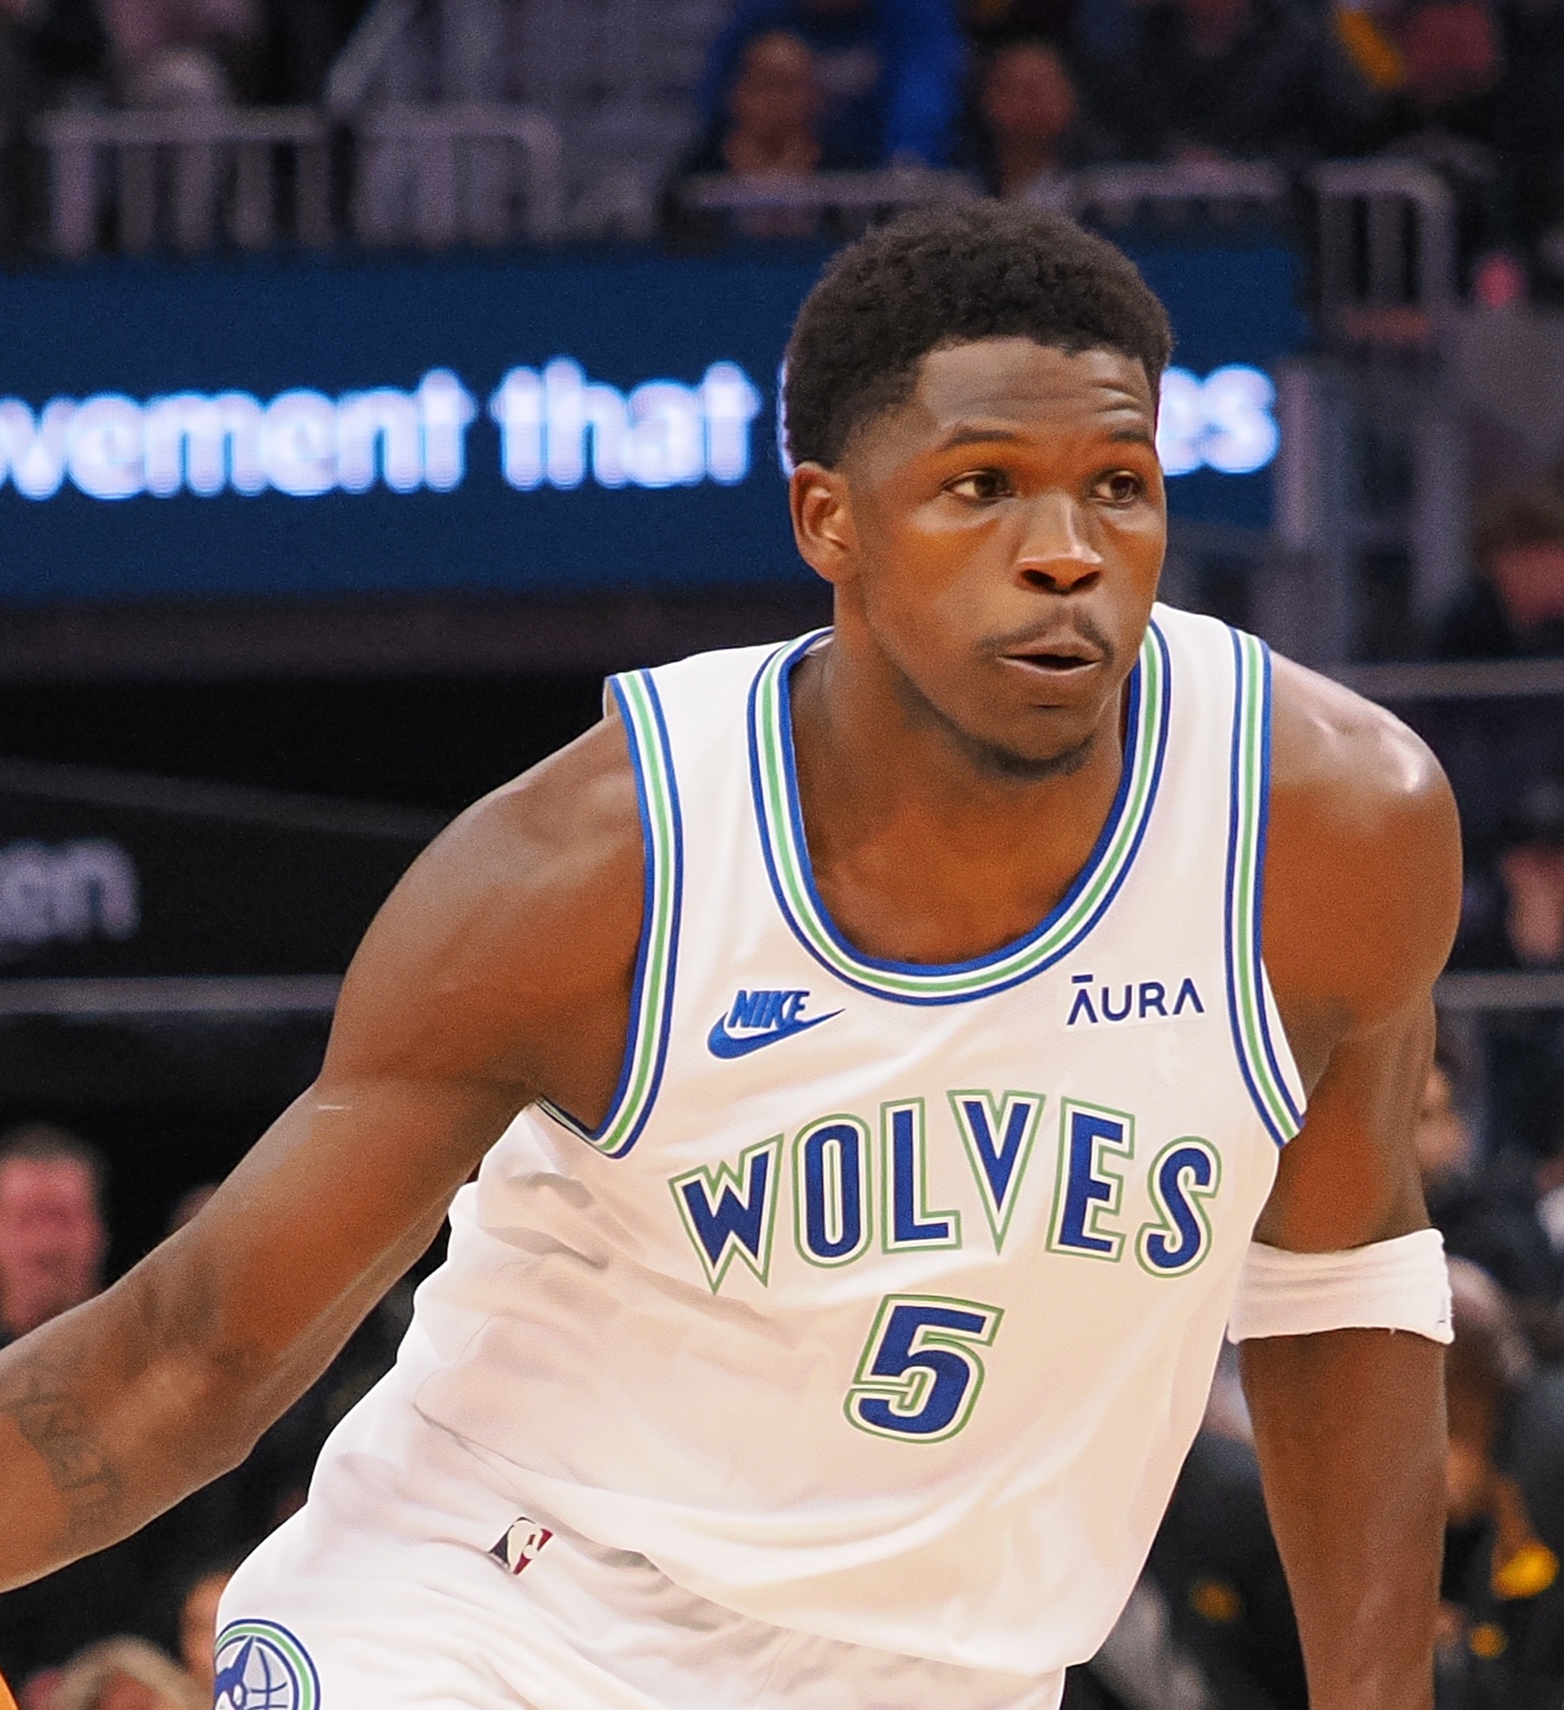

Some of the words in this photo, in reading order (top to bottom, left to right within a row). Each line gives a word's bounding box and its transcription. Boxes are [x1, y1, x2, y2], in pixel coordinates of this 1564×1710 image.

[489, 354, 764, 491] that
[727, 989, 811, 1030] NIKE
[668, 1088, 1223, 1295] WOLVES
[842, 1293, 1006, 1444] 5
